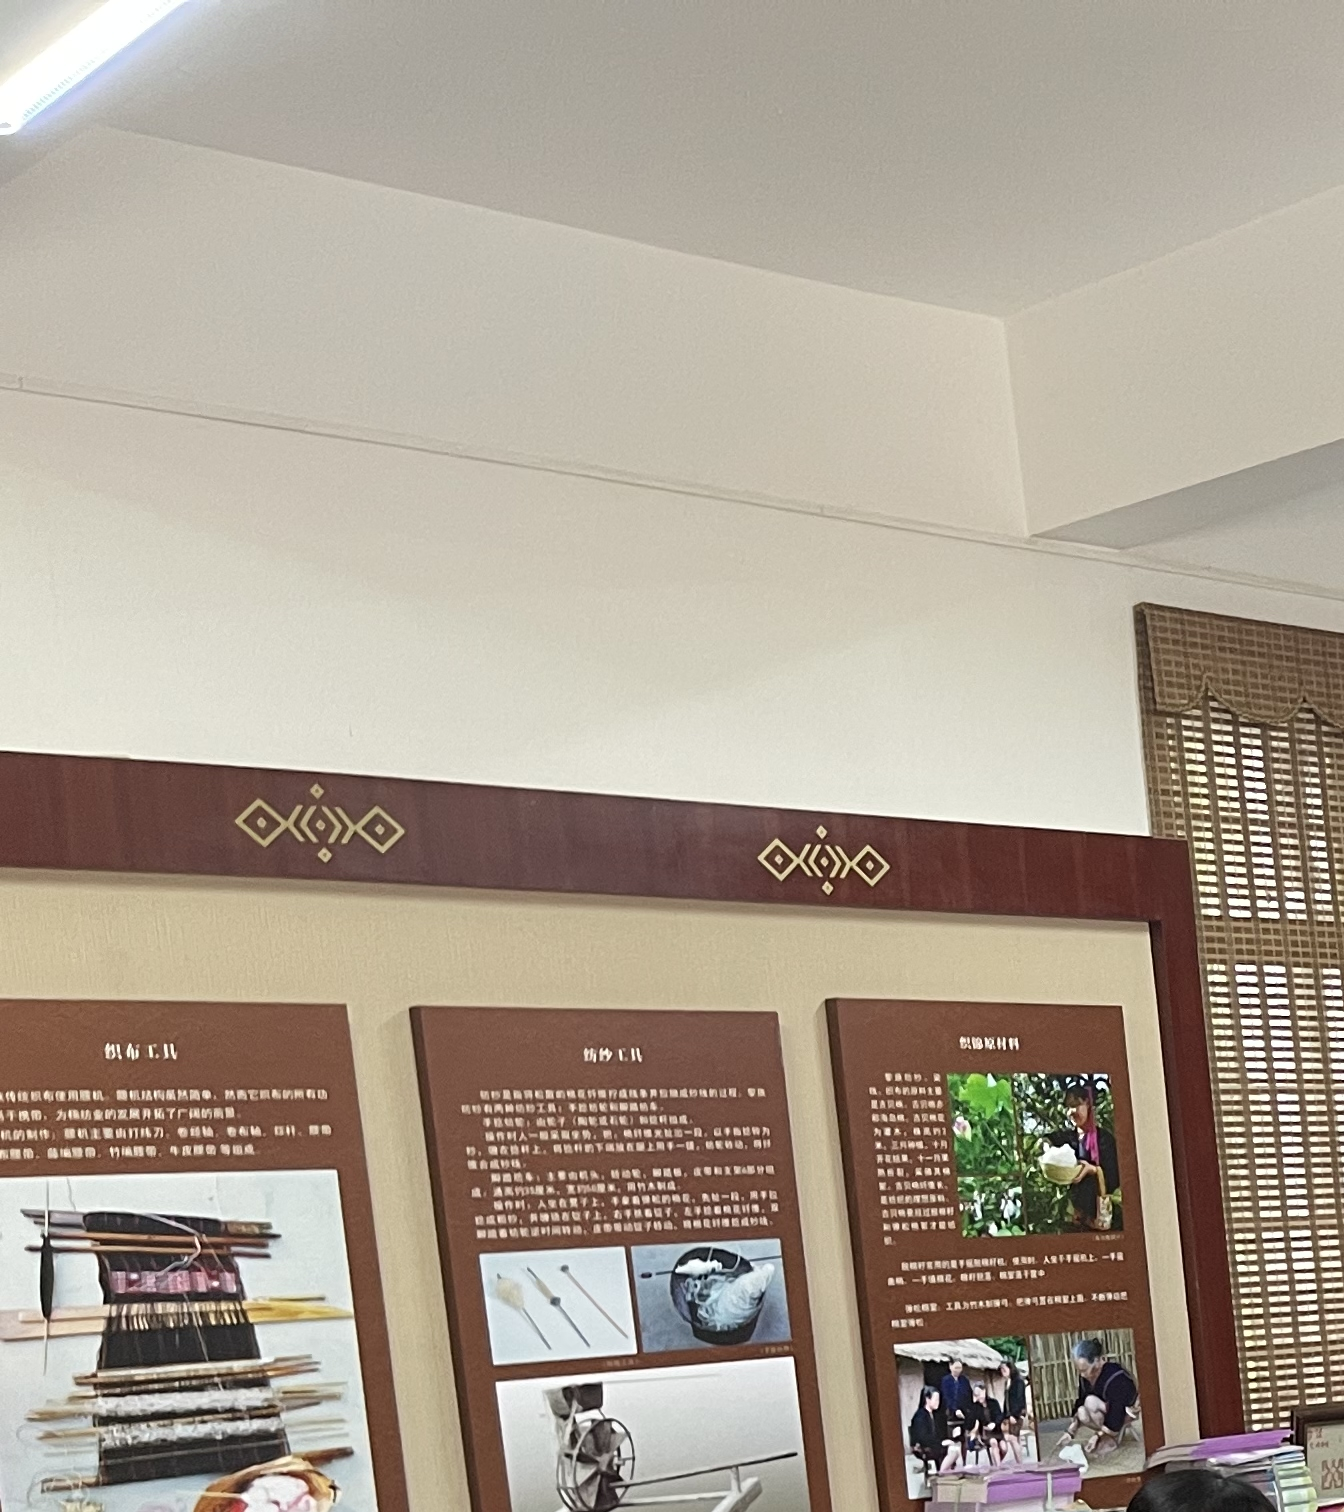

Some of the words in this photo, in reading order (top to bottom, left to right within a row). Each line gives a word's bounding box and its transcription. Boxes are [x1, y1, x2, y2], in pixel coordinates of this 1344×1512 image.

[958, 1036, 1020, 1051] 织锦原材料
